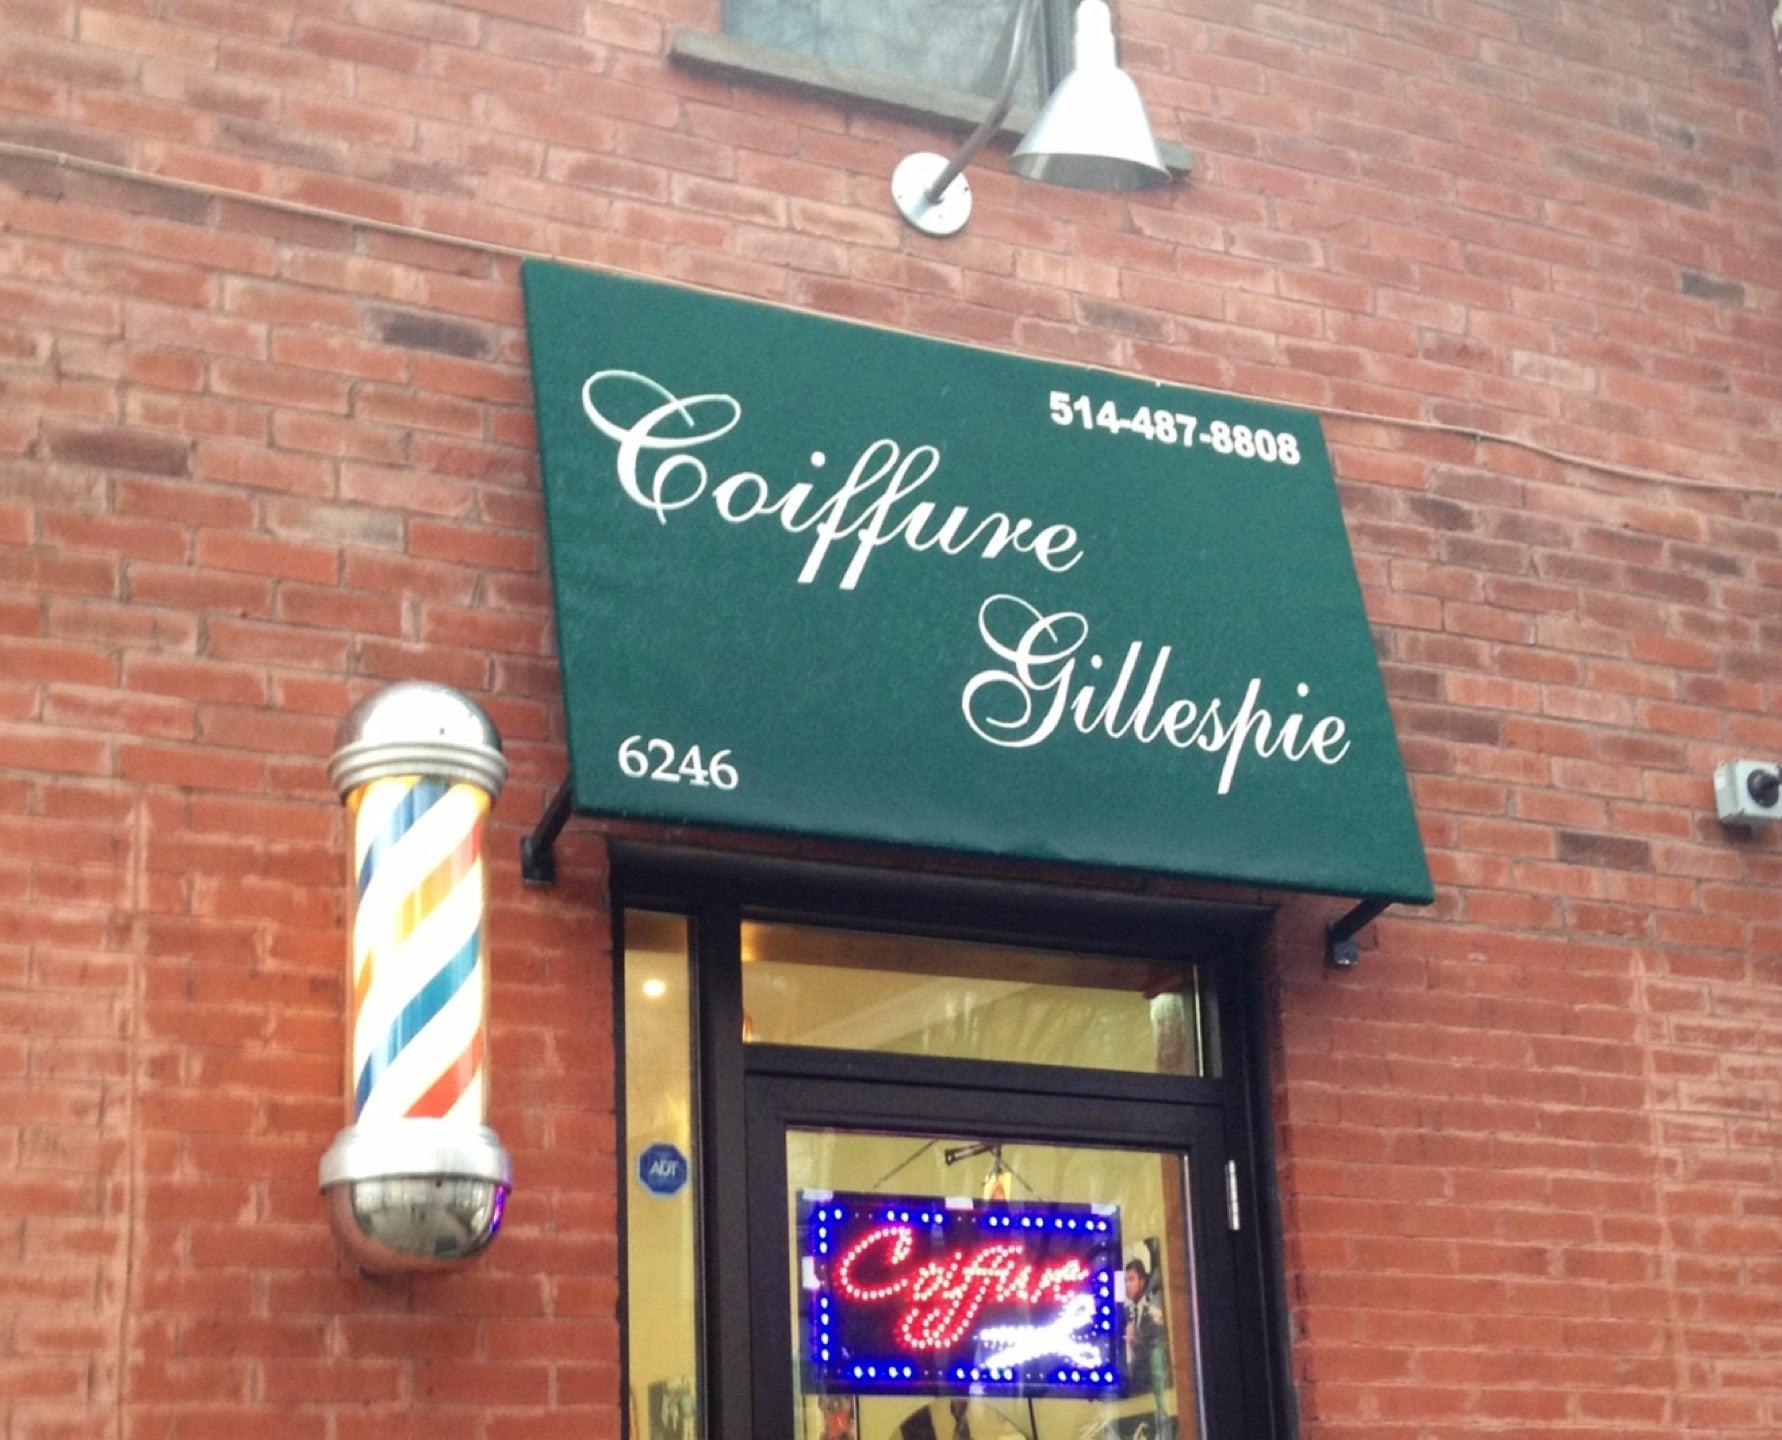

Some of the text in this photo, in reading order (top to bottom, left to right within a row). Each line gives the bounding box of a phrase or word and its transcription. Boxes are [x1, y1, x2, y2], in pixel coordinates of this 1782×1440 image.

[581, 369, 1085, 590] Coiffure
[1049, 390, 1301, 465] 514-487-8808
[617, 734, 740, 791] 6246
[961, 593, 1351, 795] Gillespie
